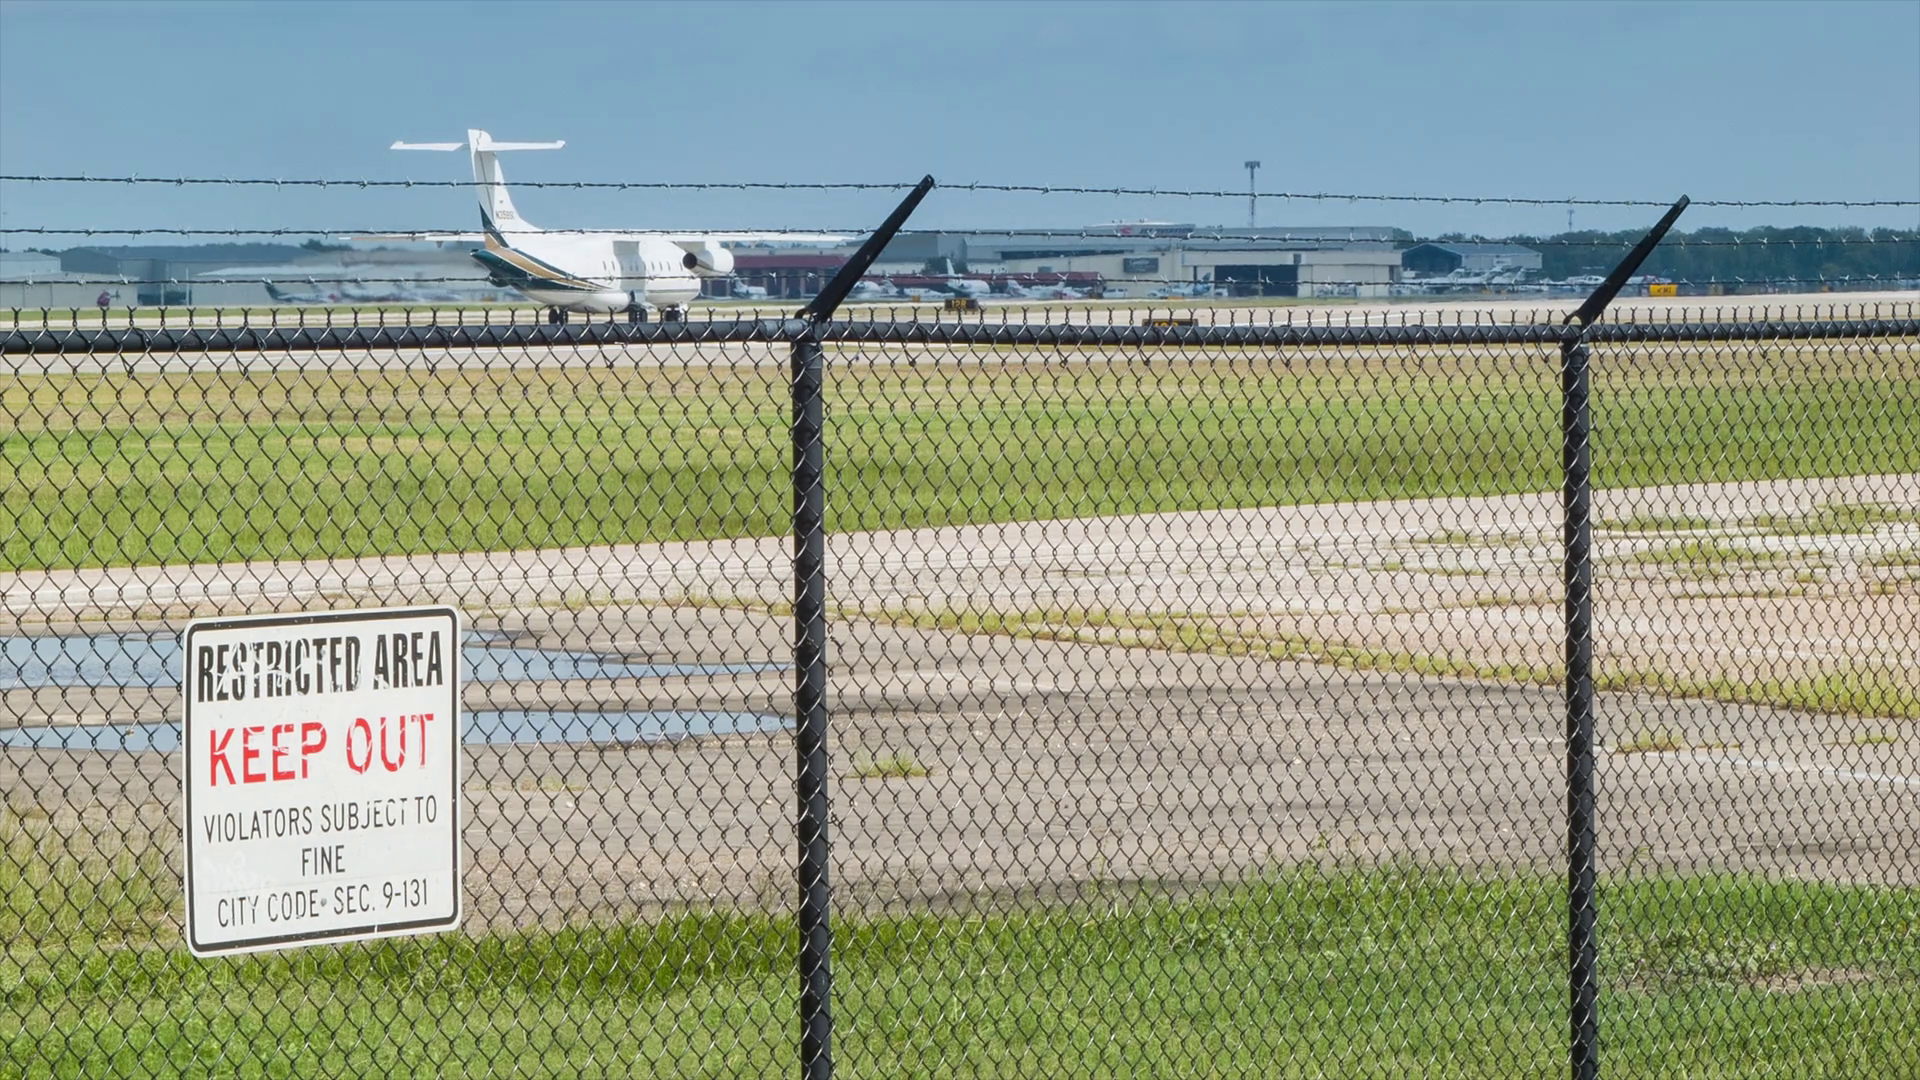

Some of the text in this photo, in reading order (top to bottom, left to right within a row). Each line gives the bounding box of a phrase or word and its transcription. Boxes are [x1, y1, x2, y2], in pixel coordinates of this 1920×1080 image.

[198, 630, 443, 703] RESTRICTED AREA
[209, 713, 434, 787] KEEP OUT
[203, 794, 437, 844] VIOLATORS SUBJECT TO
[301, 844, 346, 877] FINE
[217, 878, 428, 928] CITY CODE SEC. 9-131
